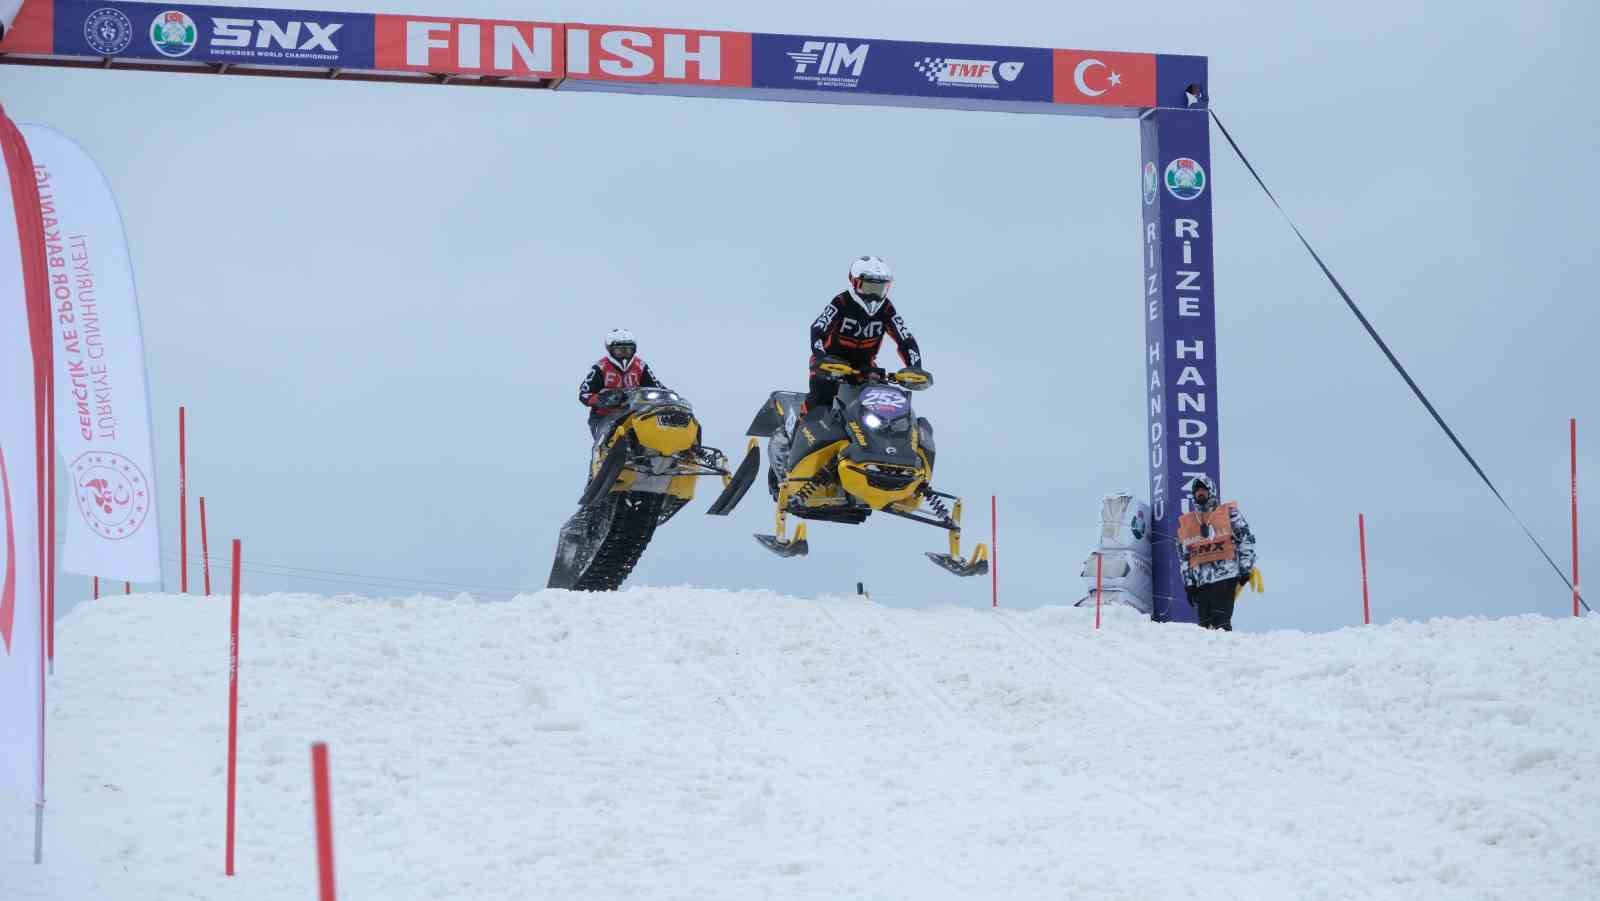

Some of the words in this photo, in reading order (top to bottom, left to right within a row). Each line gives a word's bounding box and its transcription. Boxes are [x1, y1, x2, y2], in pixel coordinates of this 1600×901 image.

[210, 17, 344, 52] SNX
[406, 20, 721, 81] FINISH
[284, 52, 339, 61] CHAMPIONSHIP
[786, 41, 870, 76] FIM
[948, 63, 990, 78] TMF
[1174, 217, 1202, 317] RİZE
[839, 317, 884, 338] FXR
[862, 391, 906, 408] 252
[1175, 339, 1208, 514] HANDÜZ
